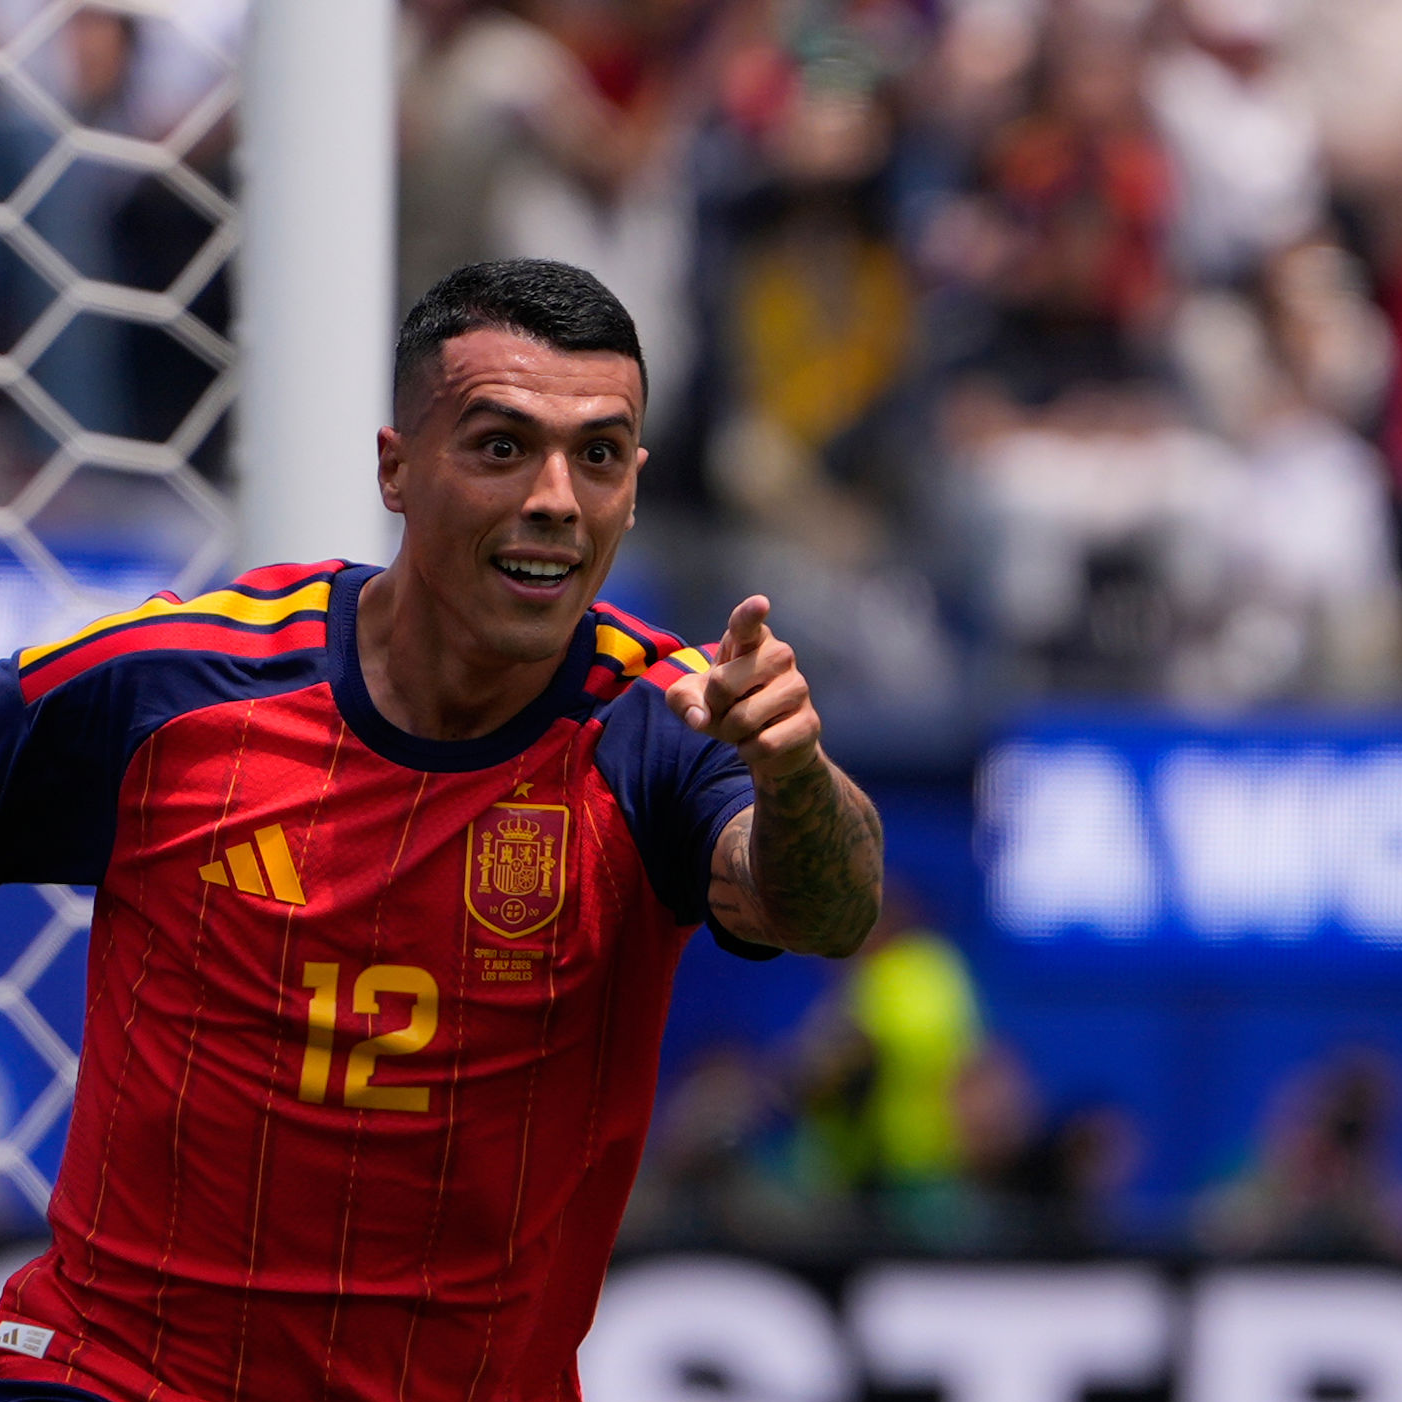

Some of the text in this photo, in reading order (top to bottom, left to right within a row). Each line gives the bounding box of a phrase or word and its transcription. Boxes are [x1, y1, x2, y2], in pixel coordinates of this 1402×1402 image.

[474, 948, 497, 959] SPAIN
[484, 960, 532, 970] 2 JULY 2026
[481, 971, 534, 981] LOS ANGELES
[299, 961, 439, 1113] 12
